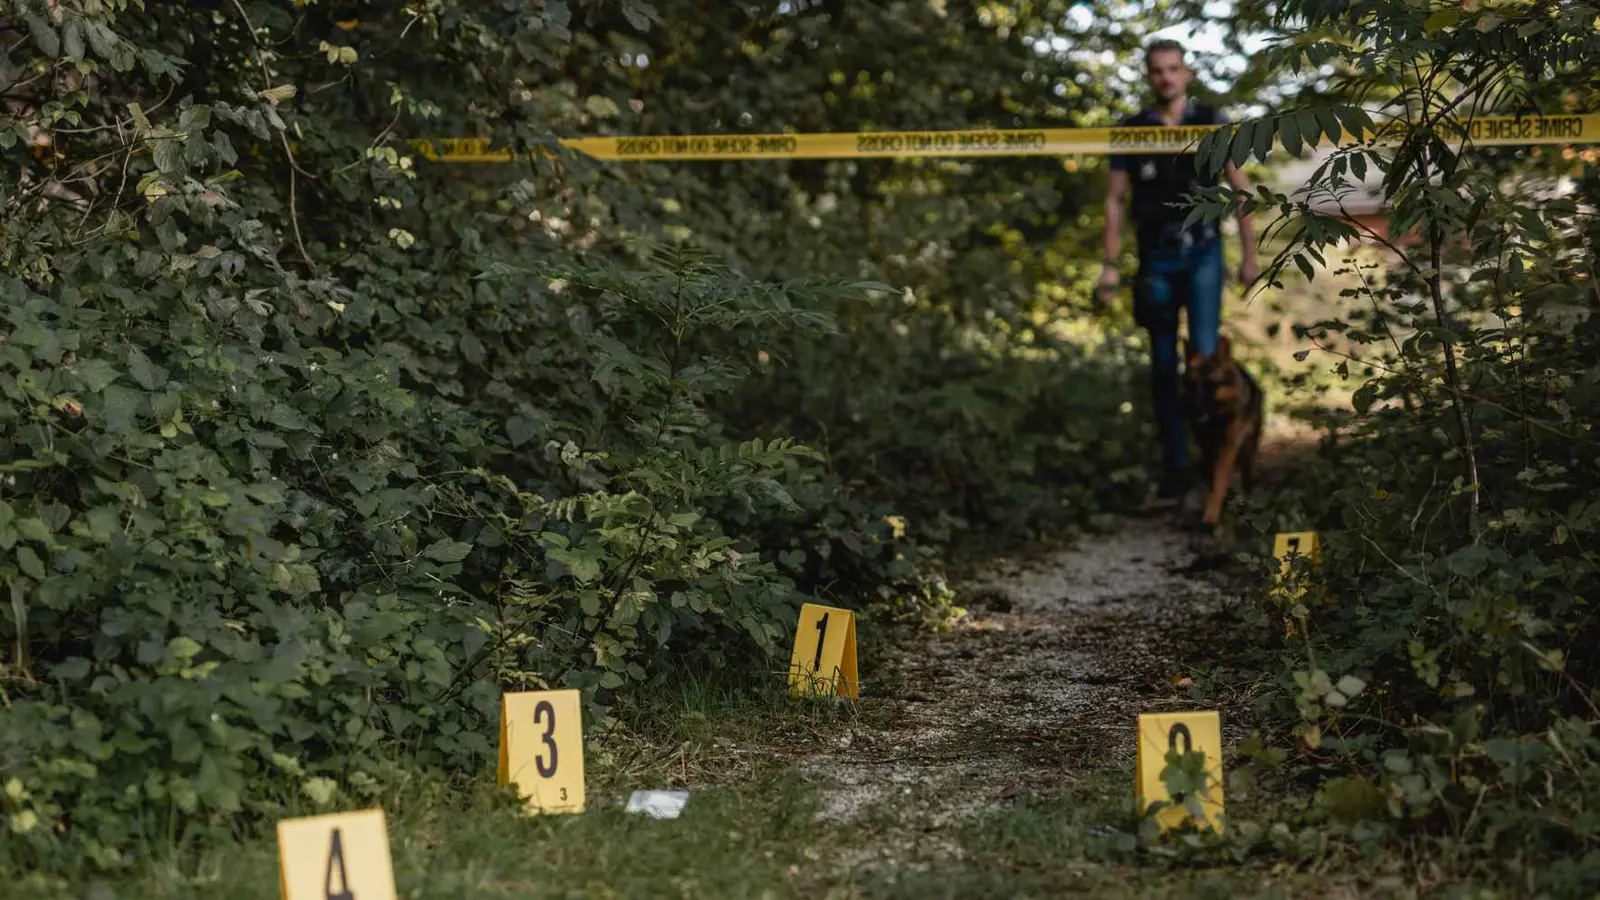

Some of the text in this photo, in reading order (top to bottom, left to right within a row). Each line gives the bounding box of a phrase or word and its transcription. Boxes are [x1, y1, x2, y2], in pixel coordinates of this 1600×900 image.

[816, 612, 829, 672] 1
[533, 700, 558, 779] 3
[560, 787, 568, 801] 3
[325, 826, 354, 900] 4
